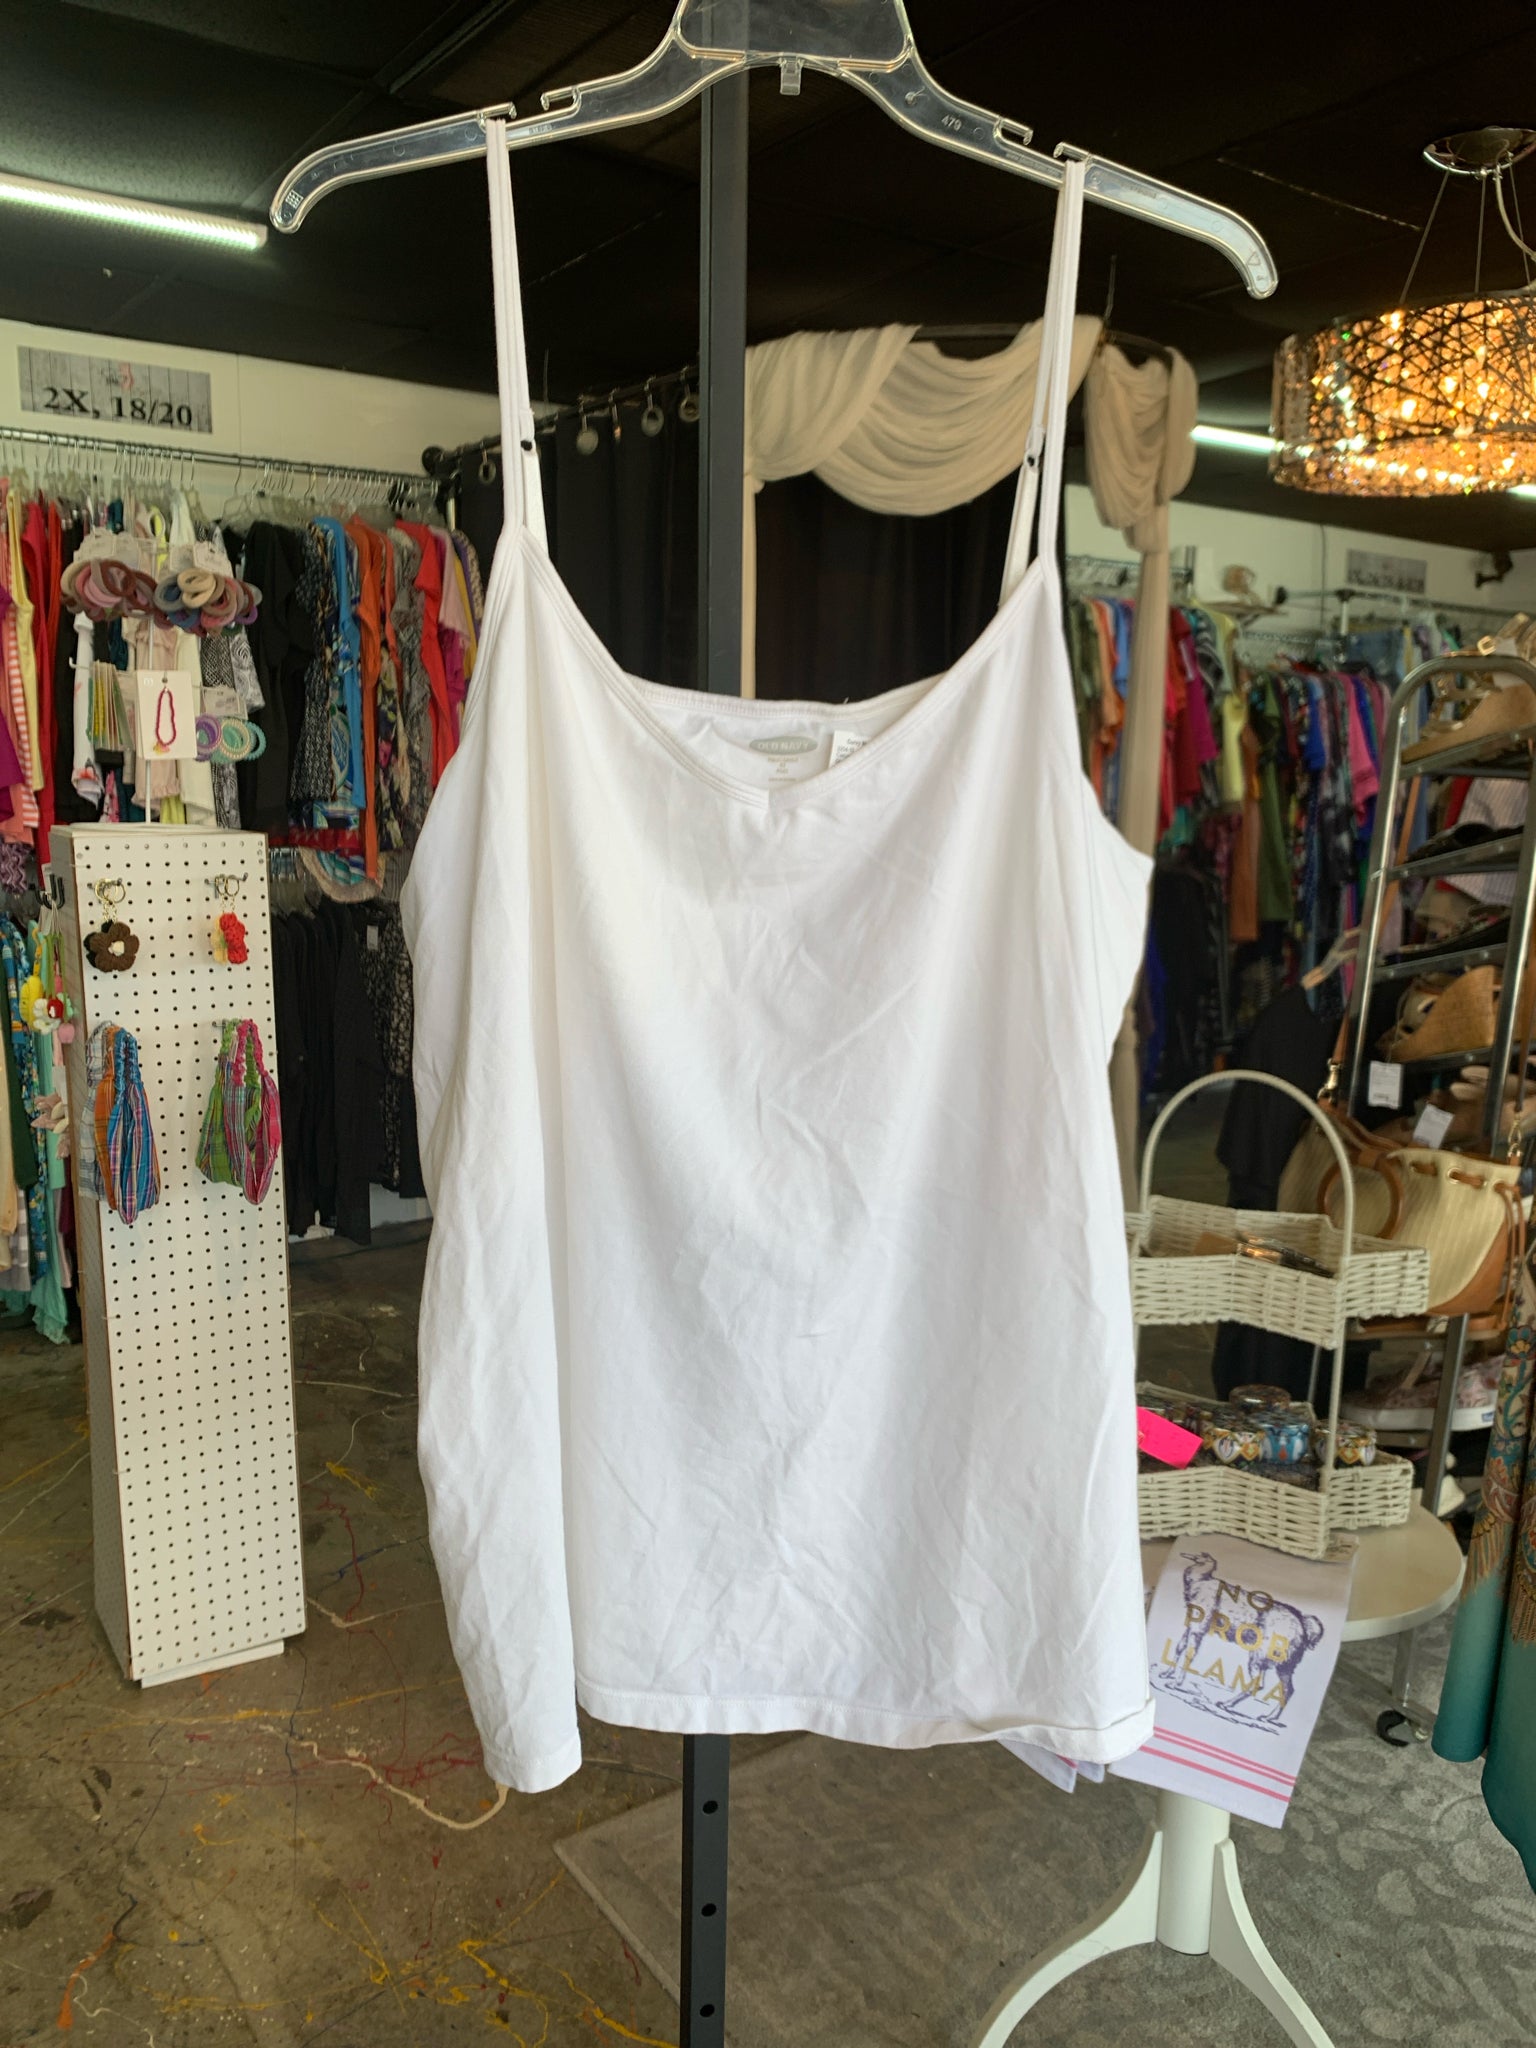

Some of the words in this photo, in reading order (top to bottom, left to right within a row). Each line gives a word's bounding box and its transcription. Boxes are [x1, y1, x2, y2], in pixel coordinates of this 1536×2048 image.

[45, 387, 100, 419] 2X,
[113, 396, 192, 426] 18/20
[758, 742, 778, 751] OLD
[780, 742, 809, 751] NAVY
[1216, 1580, 1274, 1611] NO
[1184, 1603, 1291, 1663] PROB
[1162, 1638, 1287, 1708] LLAMA
